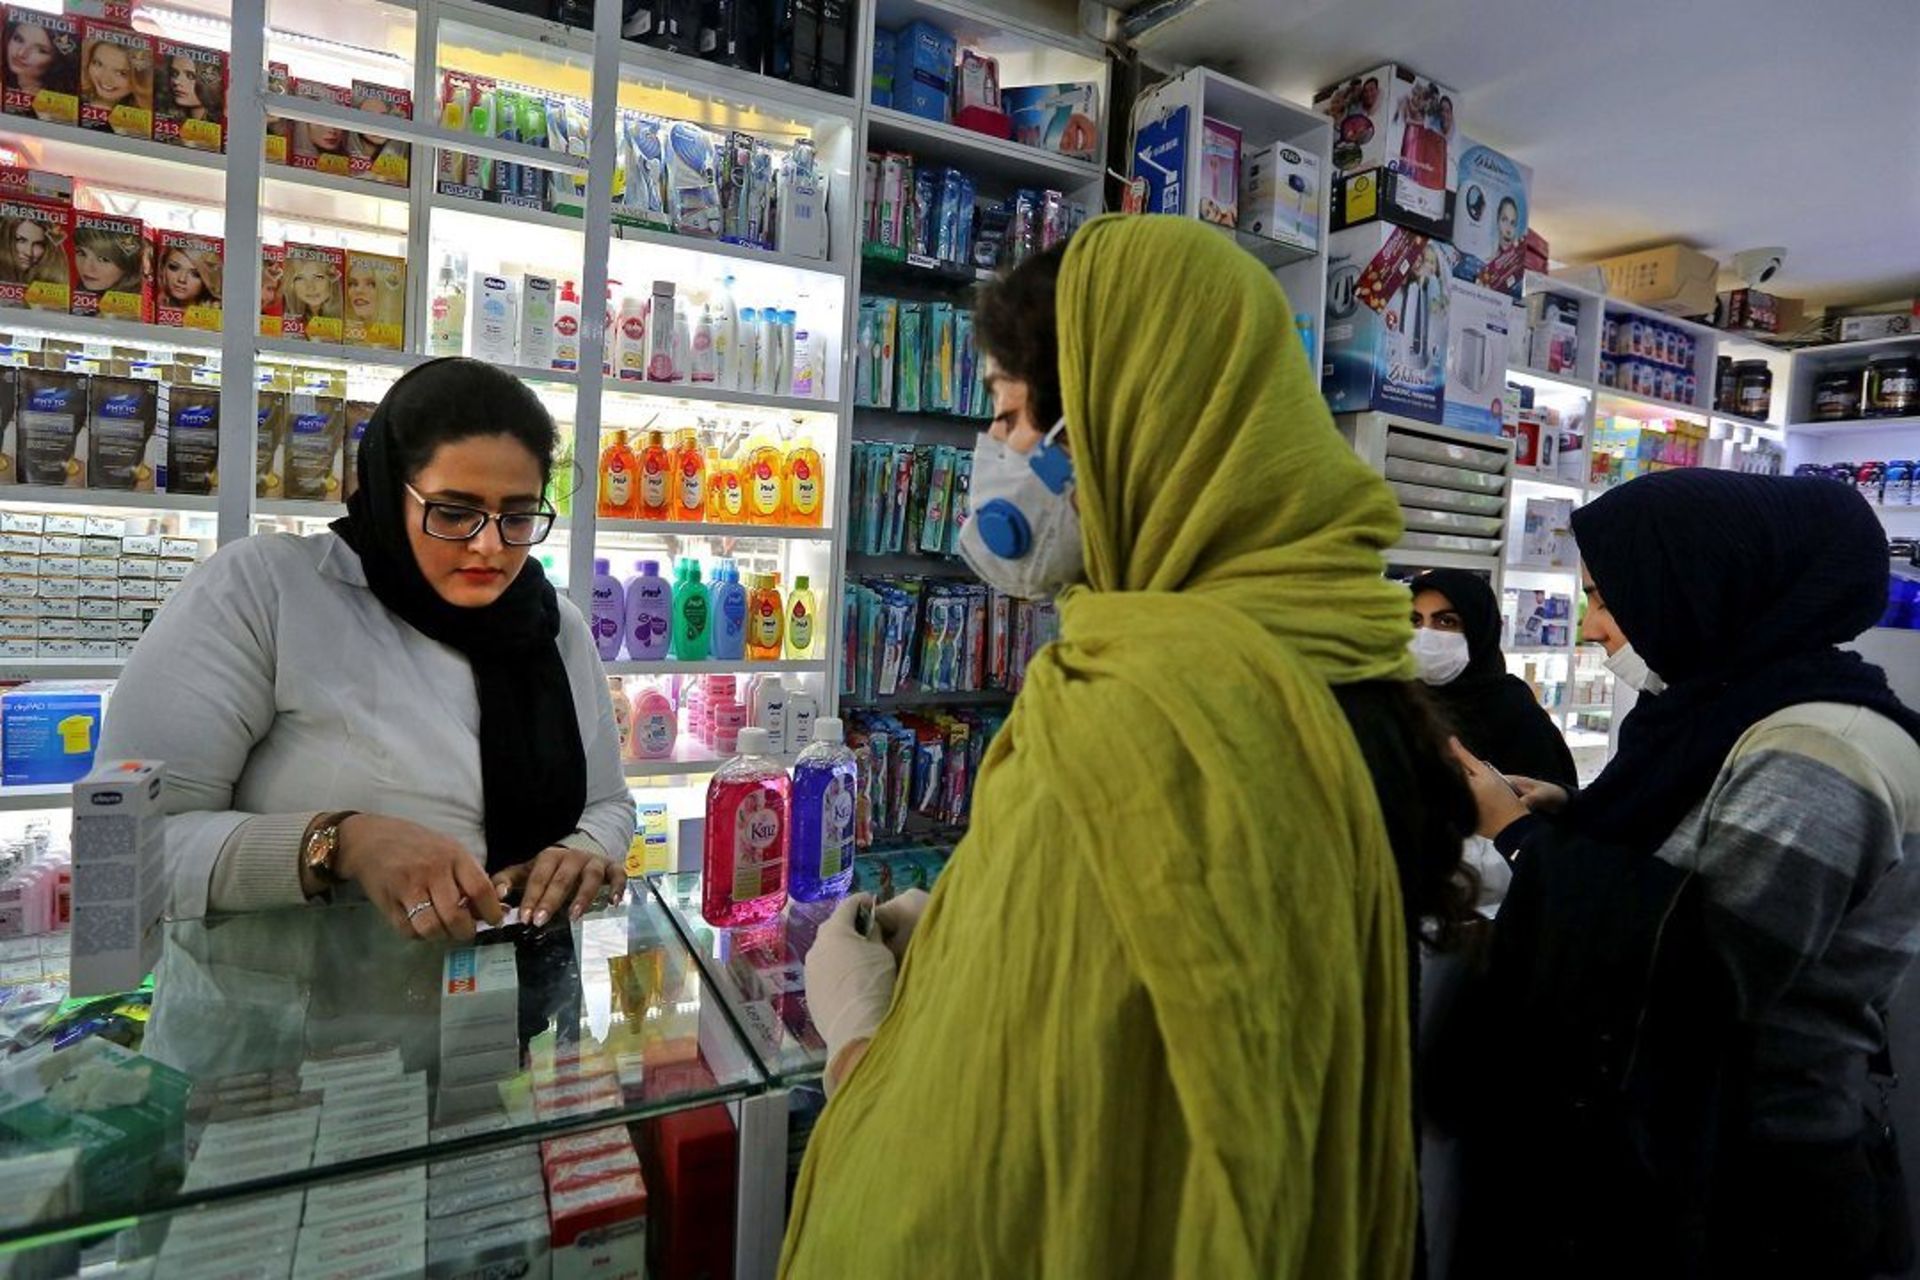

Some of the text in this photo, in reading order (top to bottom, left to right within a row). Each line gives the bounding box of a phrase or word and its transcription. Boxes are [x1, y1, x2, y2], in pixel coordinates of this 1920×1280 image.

[8, 9, 77, 34] PRESTIGE
[86, 26, 151, 51] PRESTIGE
[158, 42, 220, 65] PRESTIGE
[6, 92, 32, 107] 215
[354, 84, 410, 106] PRESTIGE
[82, 107, 109, 123] 214
[155, 120, 180, 135] 213
[1, 171, 27, 185] 206
[1, 204, 68, 225] PRESTIGE
[76, 214, 141, 236] PRESTIGE
[162, 232, 221, 254] PRESTIGE
[287, 245, 344, 265] PRESTIGE
[0, 286, 24, 300] 205
[72, 295, 98, 310] 204
[158, 311, 183, 325] 203
[105, 403, 137, 414] PHYTO
[179, 413, 210, 425] PHYTO
